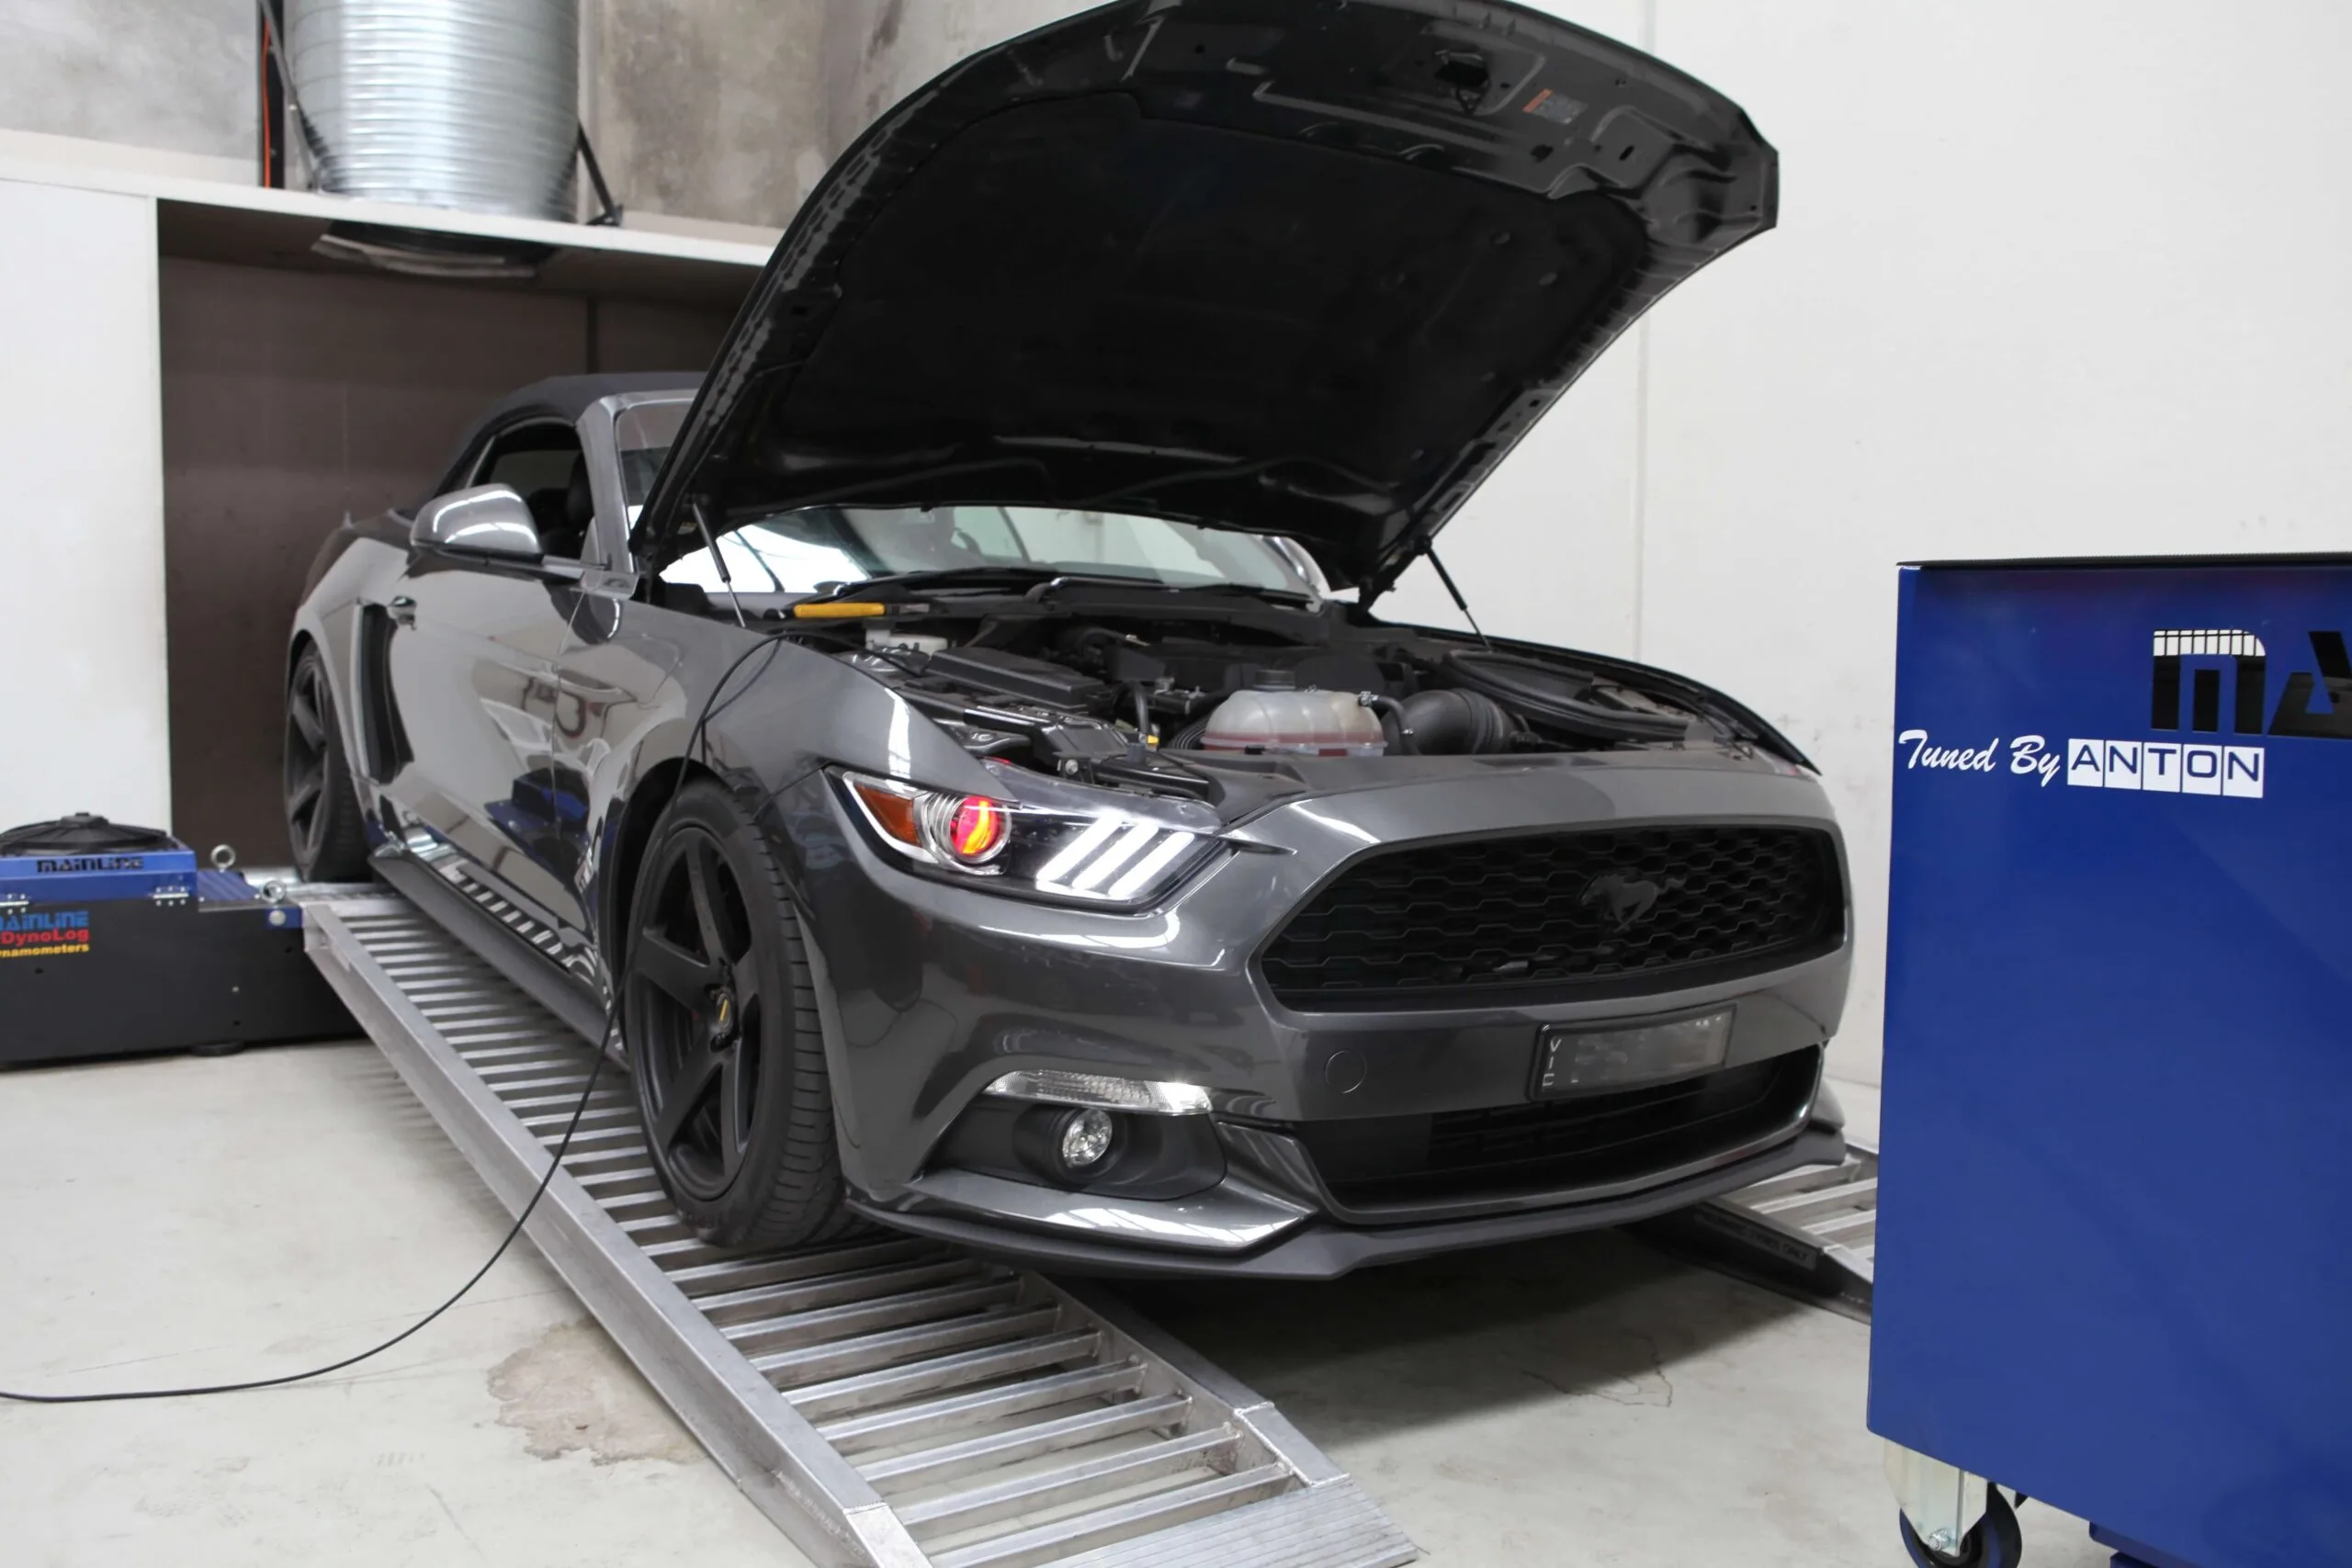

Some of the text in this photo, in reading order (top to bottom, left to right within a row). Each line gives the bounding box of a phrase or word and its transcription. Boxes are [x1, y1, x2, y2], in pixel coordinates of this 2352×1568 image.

[1898, 729, 2261, 789] Tuned By ANTON
[1, 927, 89, 948] DynoLog
